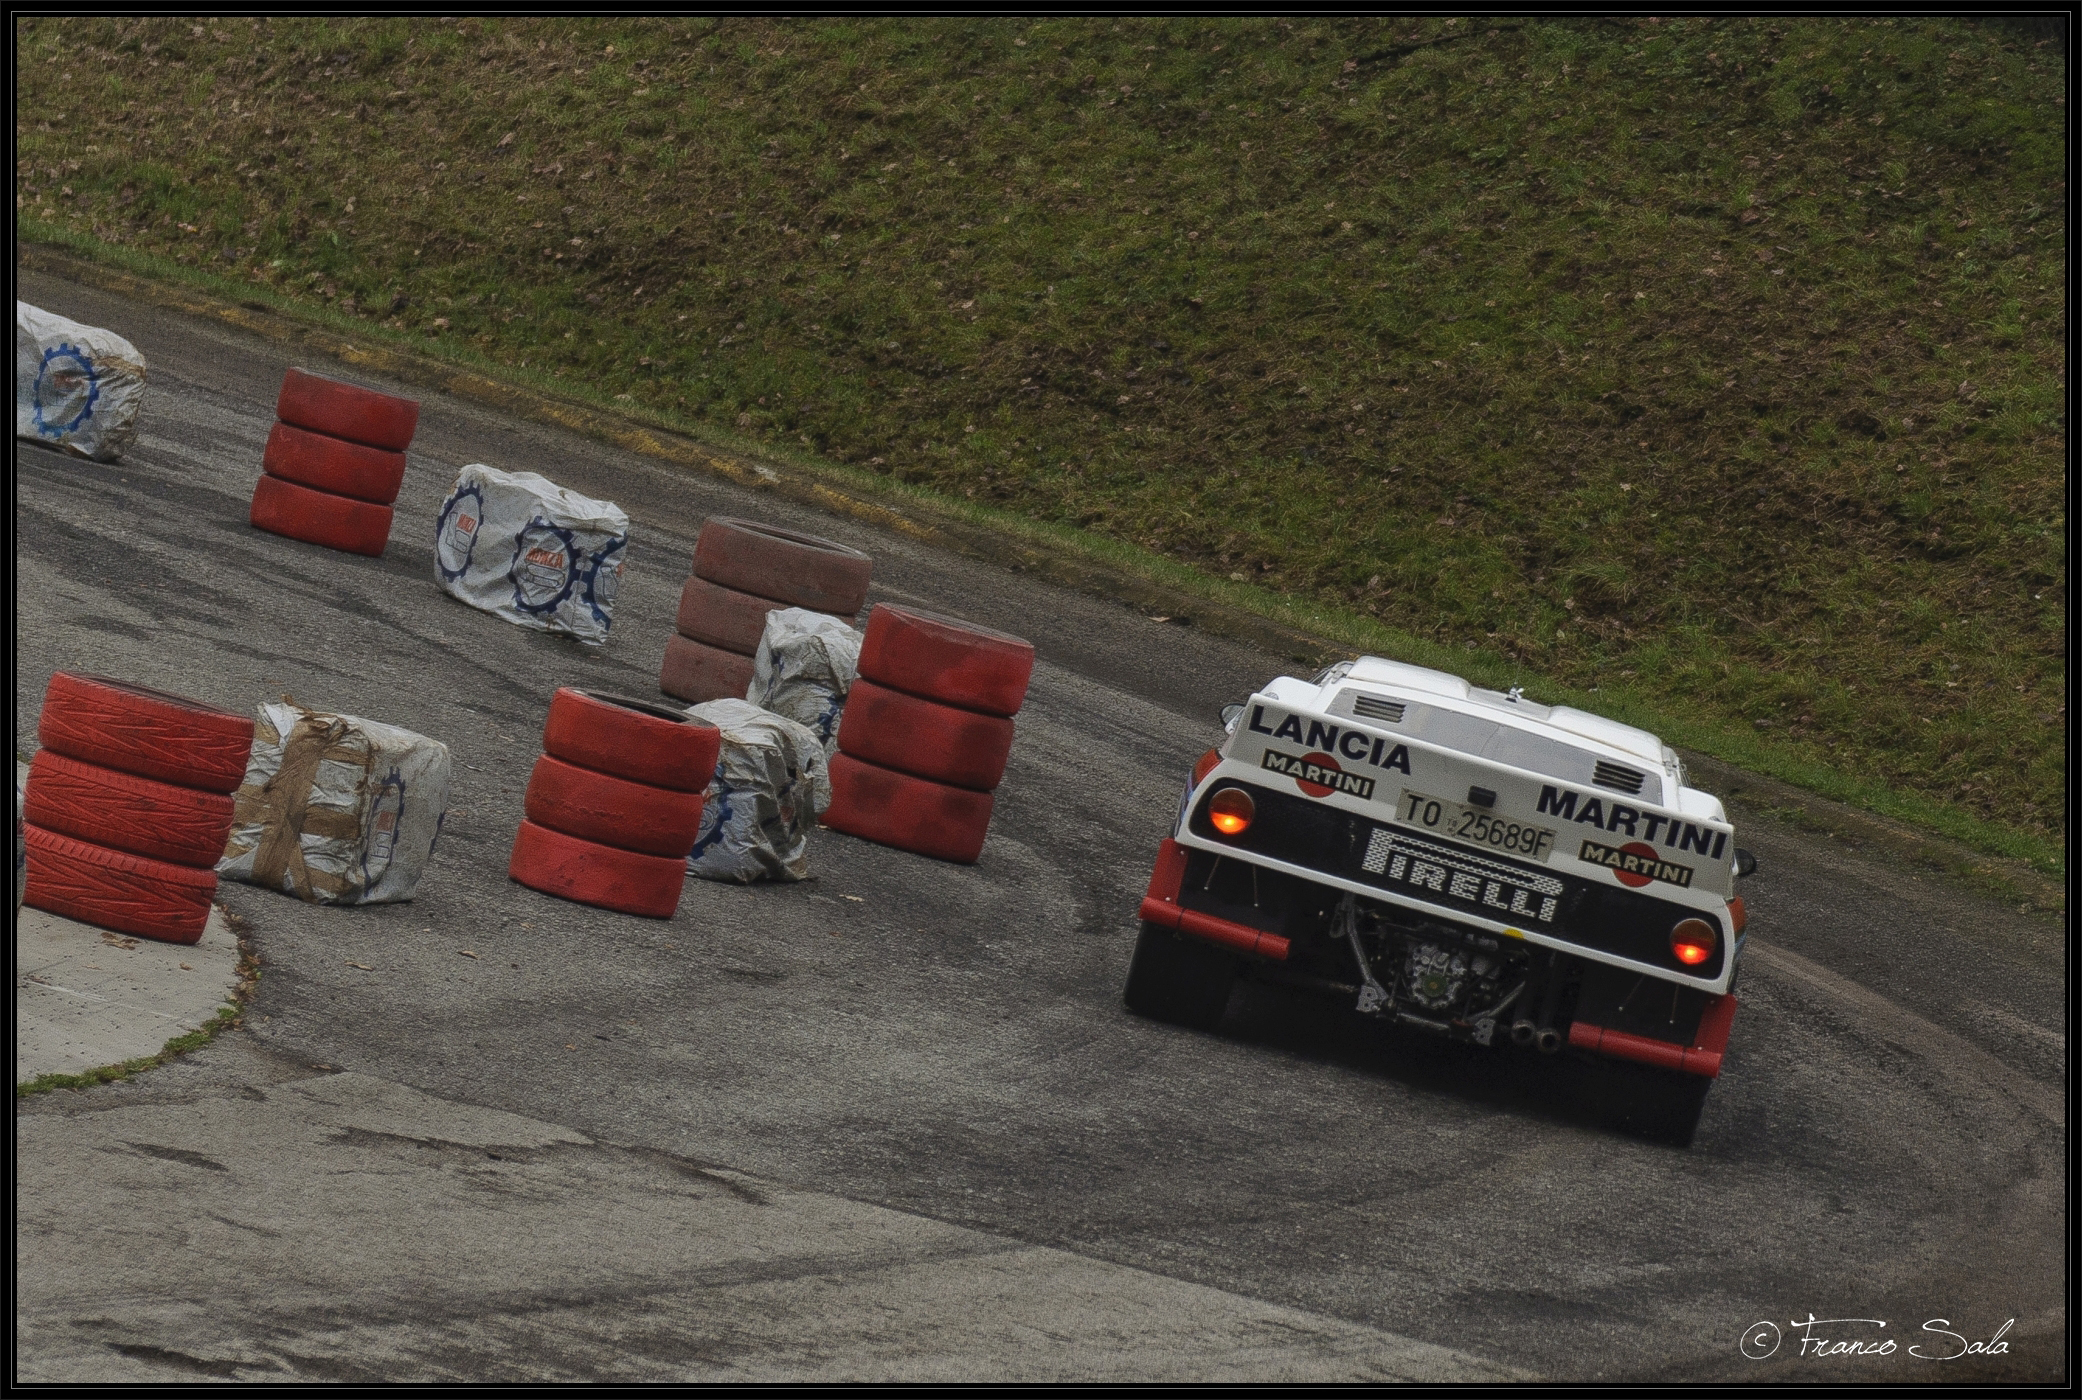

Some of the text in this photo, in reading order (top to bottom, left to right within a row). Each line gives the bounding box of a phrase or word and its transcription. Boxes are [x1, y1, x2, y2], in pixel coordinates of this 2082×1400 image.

[1248, 704, 1411, 776] LANCIA
[1266, 752, 1372, 797] MARTINI
[1406, 793, 1441, 827] TO
[1456, 810, 1553, 856] 25689F
[1536, 784, 1728, 860] MARTINI
[1362, 827, 1563, 922] PIRELLI
[1583, 843, 1691, 886] MARTINI
